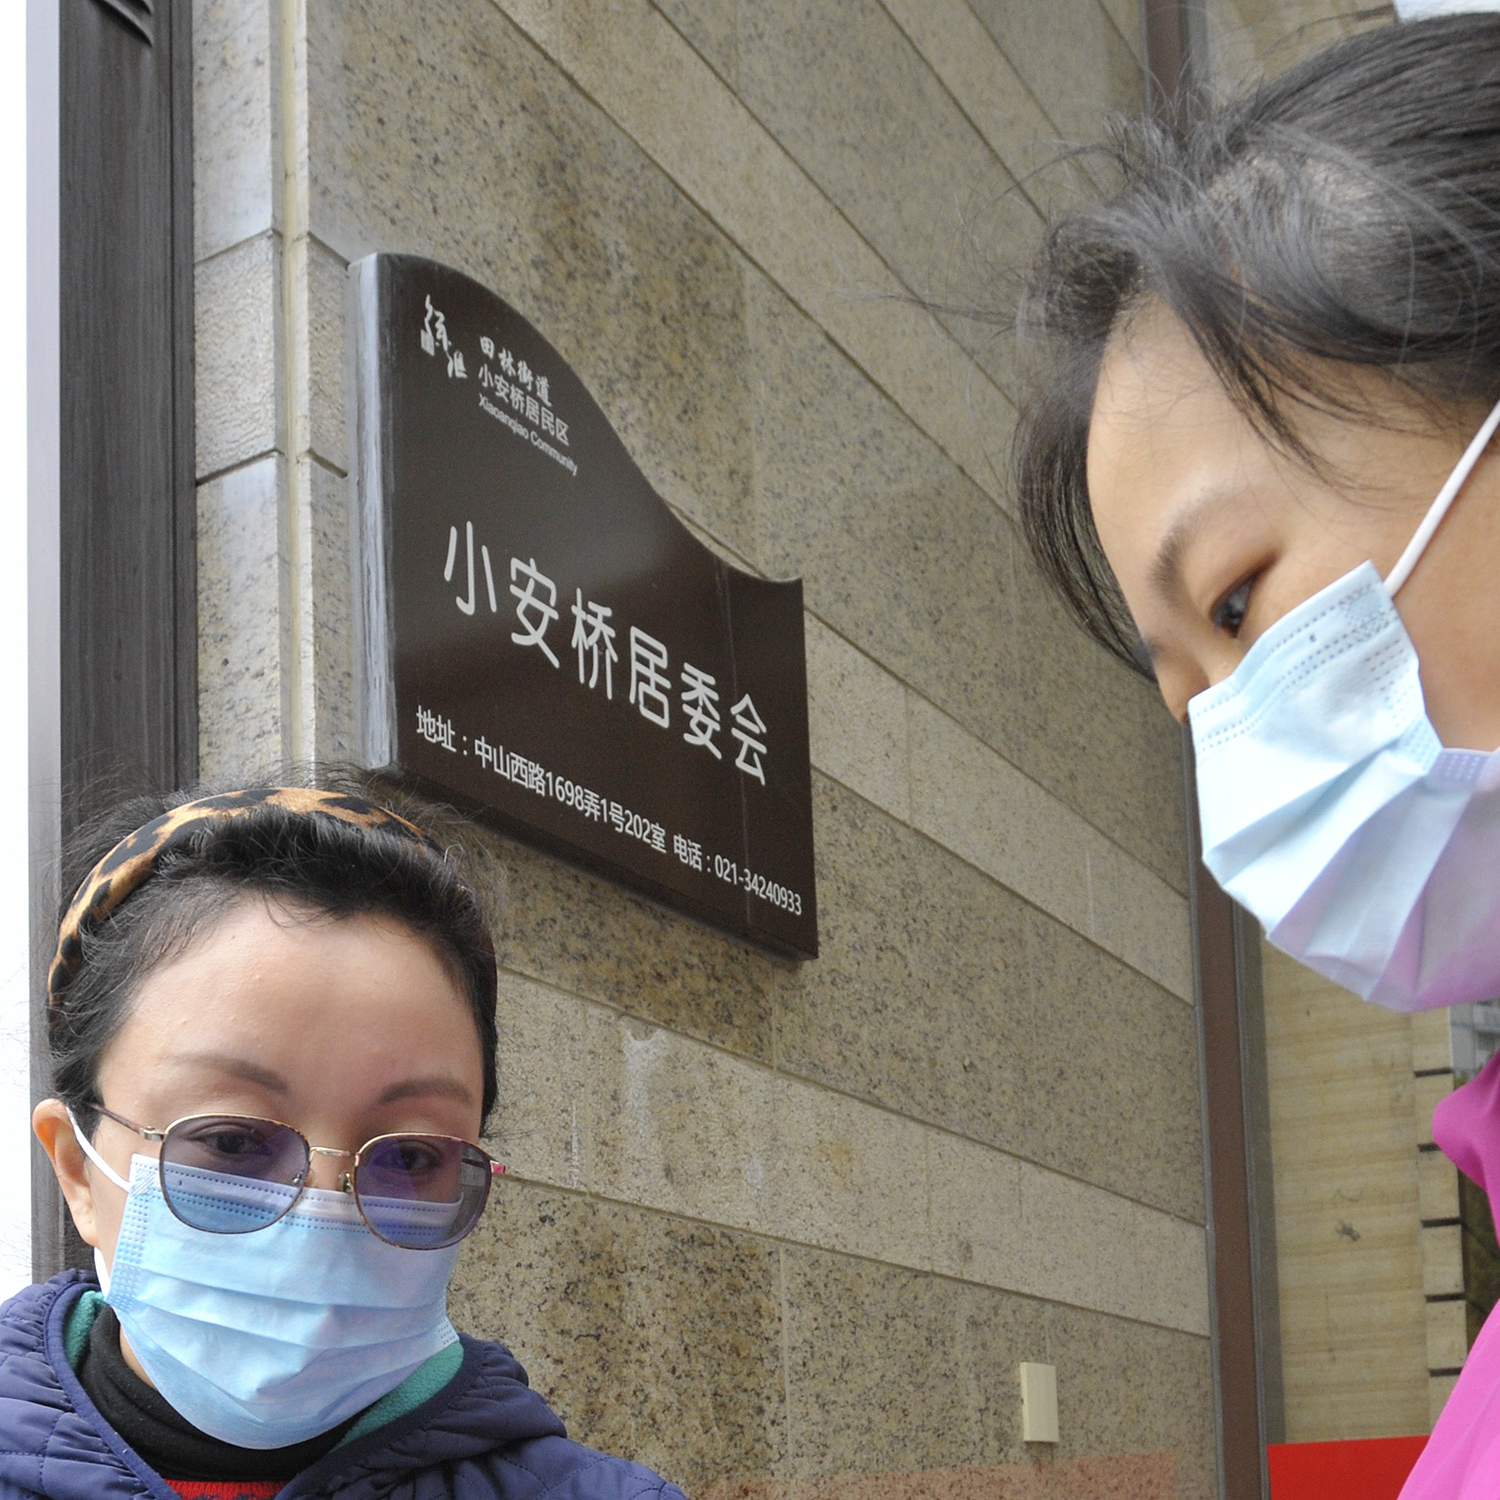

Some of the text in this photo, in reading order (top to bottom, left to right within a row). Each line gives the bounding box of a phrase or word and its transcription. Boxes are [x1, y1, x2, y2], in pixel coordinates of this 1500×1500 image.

[478, 363, 571, 447] 小安桥居民区
[479, 392, 579, 477] Xiaoanqiao Community
[444, 520, 768, 787] 小安桥居委会
